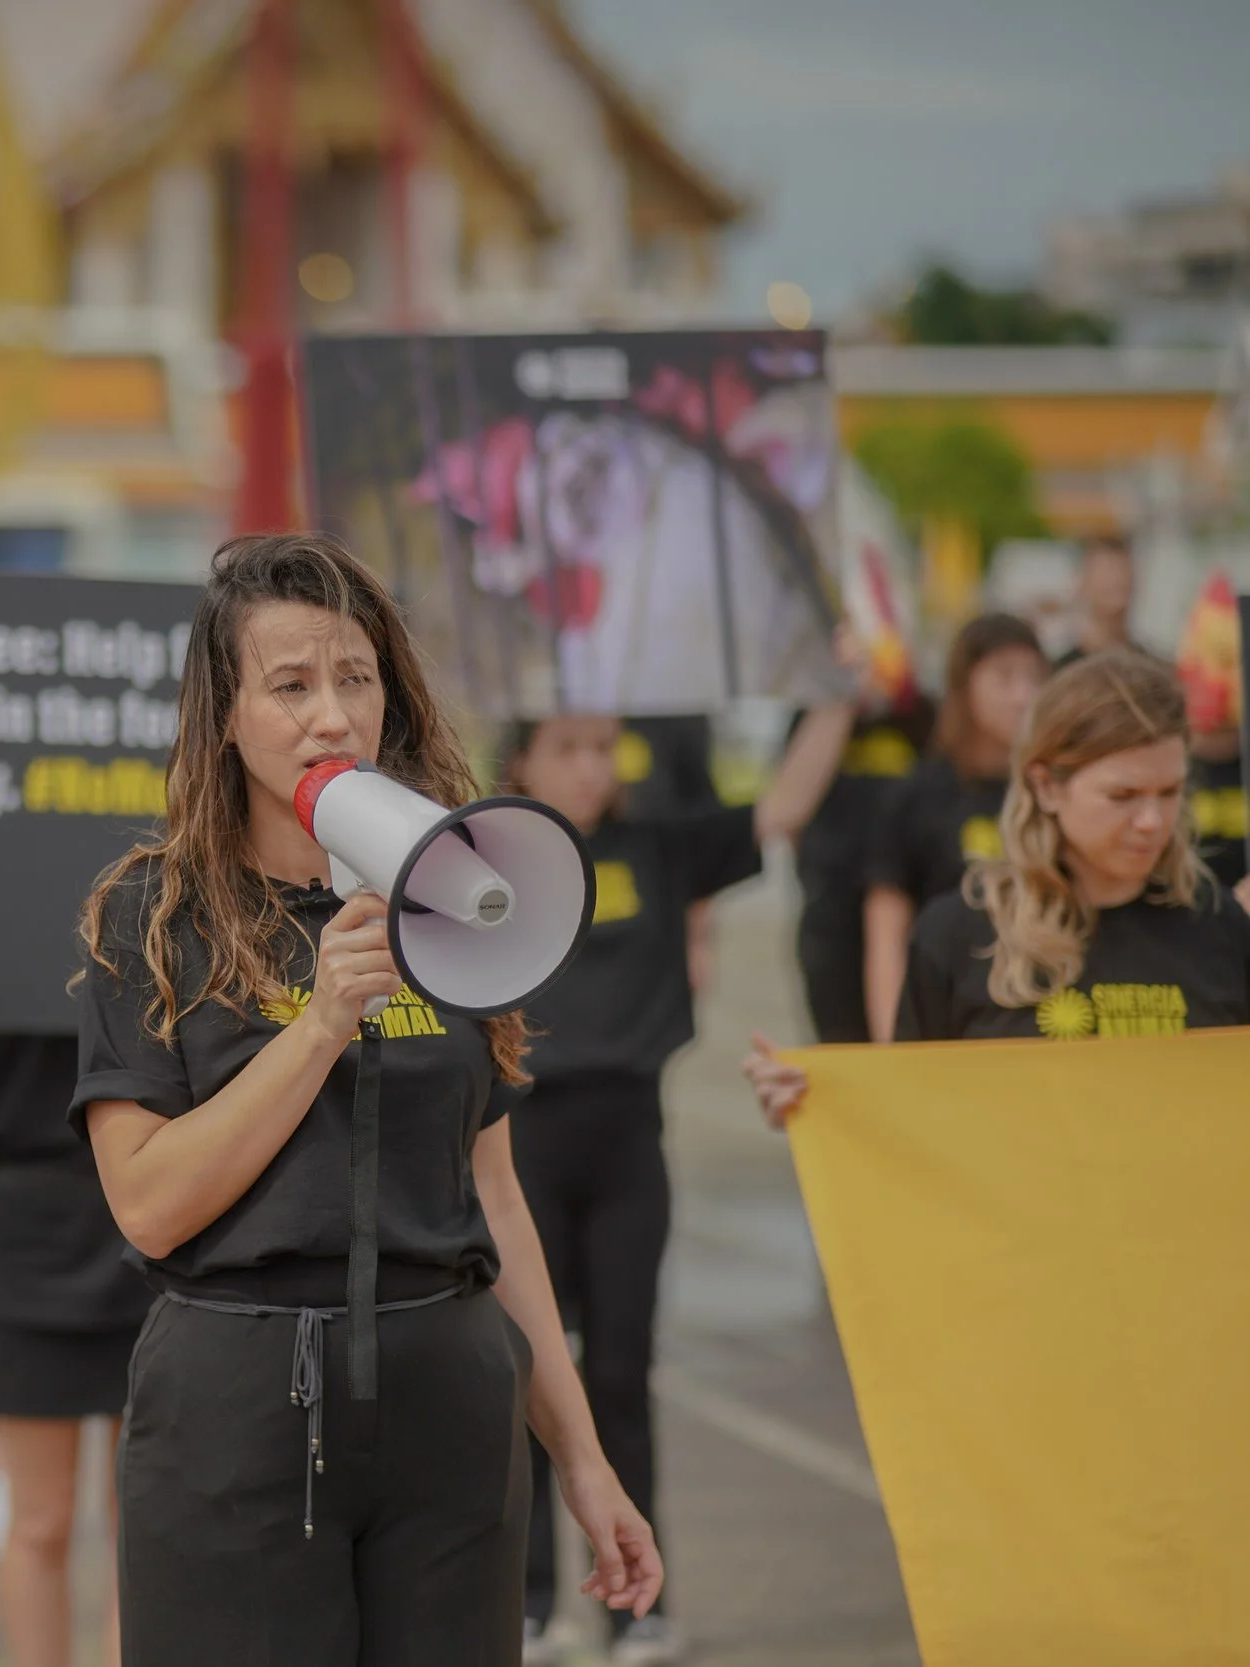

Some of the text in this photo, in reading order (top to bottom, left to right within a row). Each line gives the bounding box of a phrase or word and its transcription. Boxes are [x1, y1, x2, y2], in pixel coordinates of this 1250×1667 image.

[63, 619, 166, 690] Help
[37, 686, 115, 746] the
[479, 903, 506, 911] SONAR
